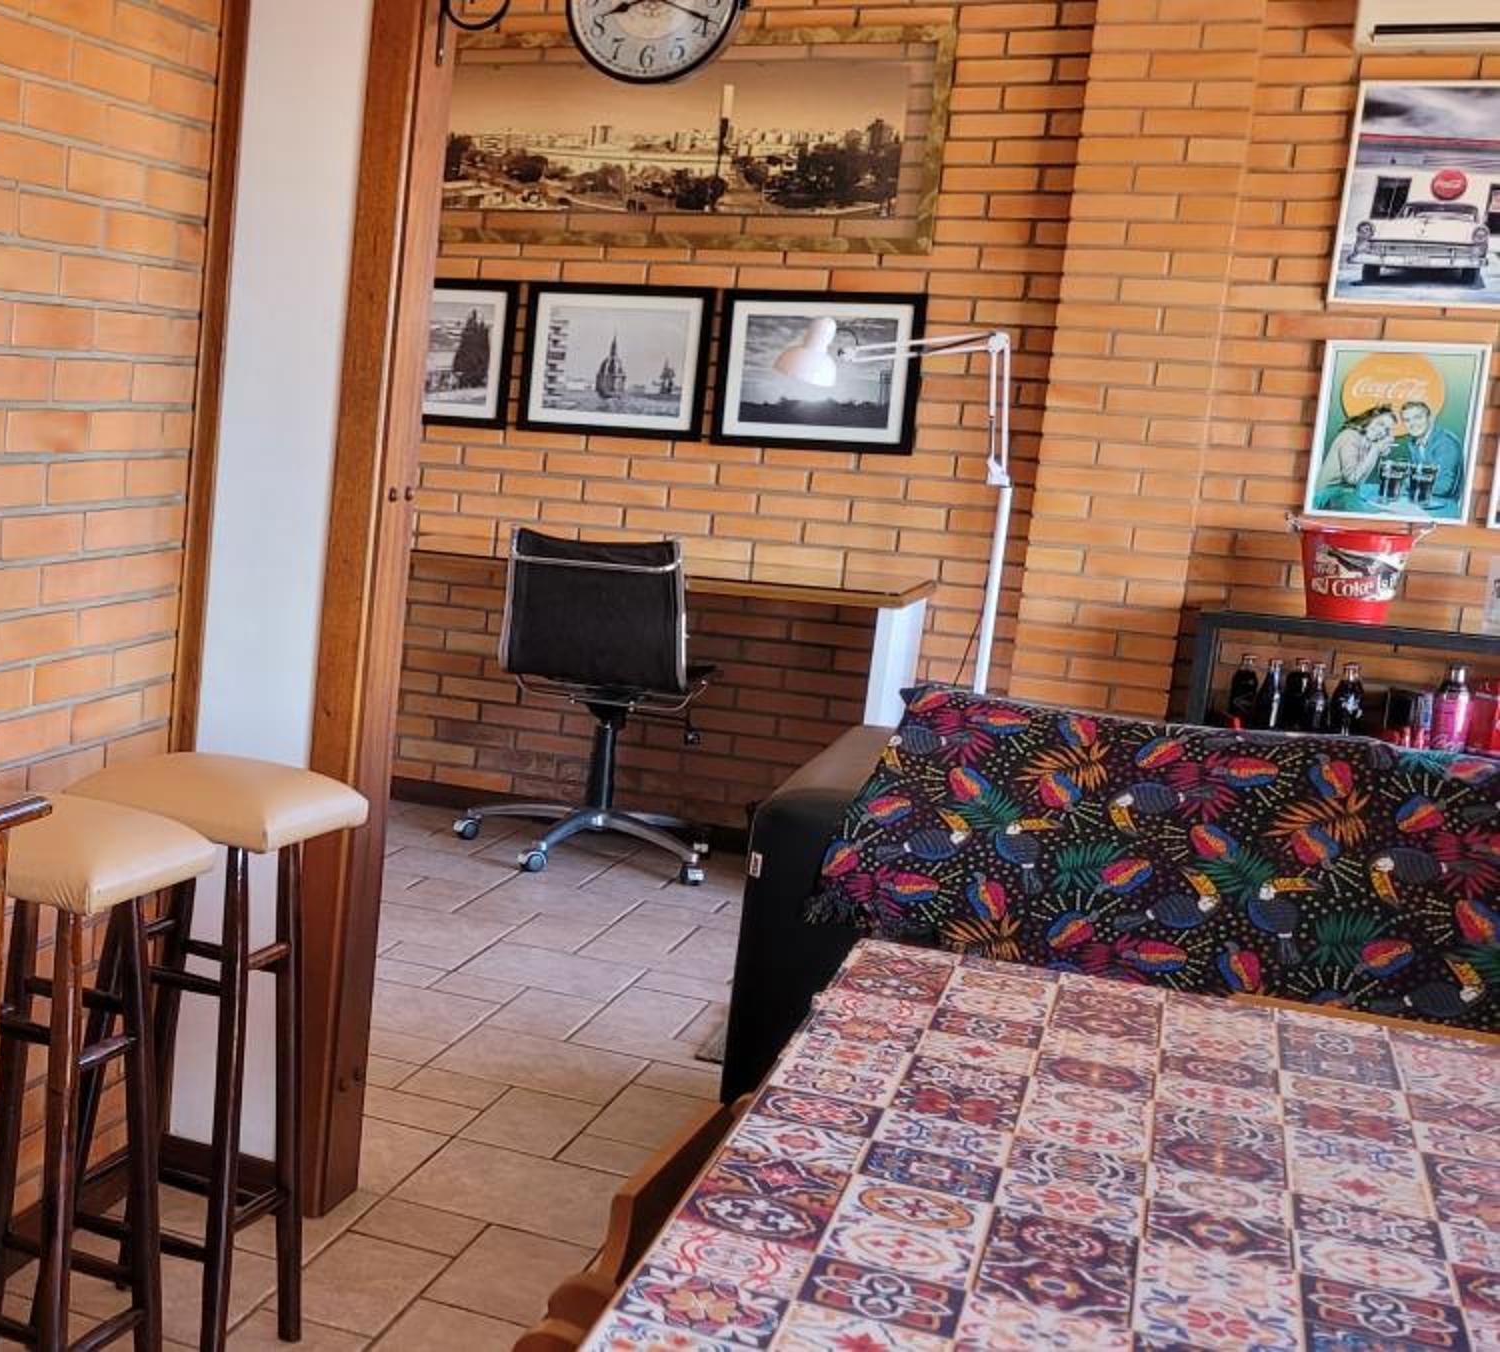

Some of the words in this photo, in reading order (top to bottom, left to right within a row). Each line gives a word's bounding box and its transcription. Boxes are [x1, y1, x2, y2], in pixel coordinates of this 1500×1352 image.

[590, 15, 605, 38] 8
[692, 15, 709, 38] 4
[612, 38, 625, 61] 7
[639, 45, 655, 69] 6
[669, 38, 685, 61] 5
